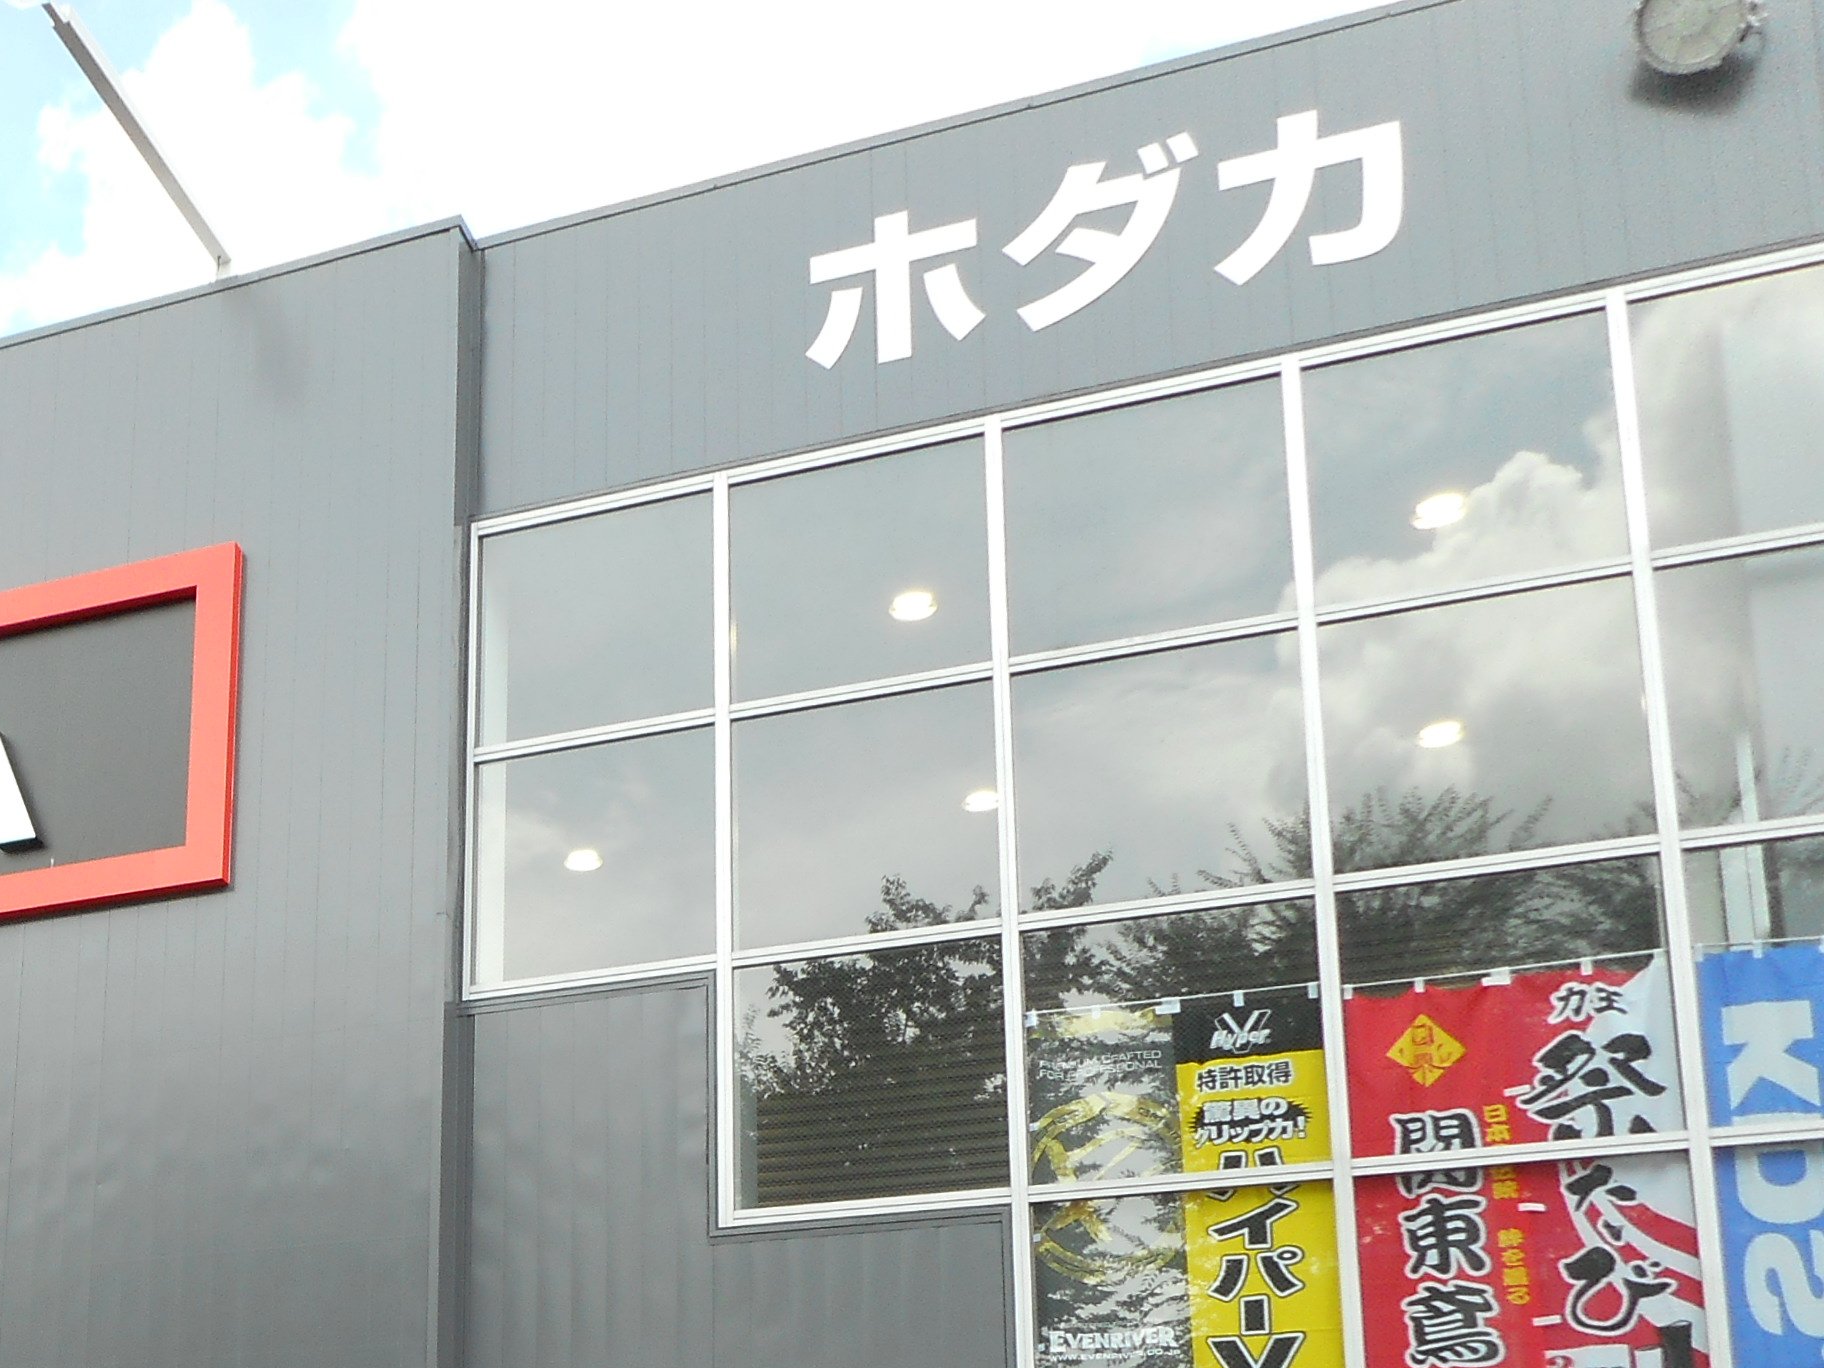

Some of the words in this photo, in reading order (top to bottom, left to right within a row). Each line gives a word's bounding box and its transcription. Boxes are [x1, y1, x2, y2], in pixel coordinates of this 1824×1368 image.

[806, 108, 1405, 369] ホダカ
[1548, 983, 1628, 1023] 力王
[1196, 1060, 1292, 1092] 特許取得
[1203, 1096, 1287, 1124] 驚異の
